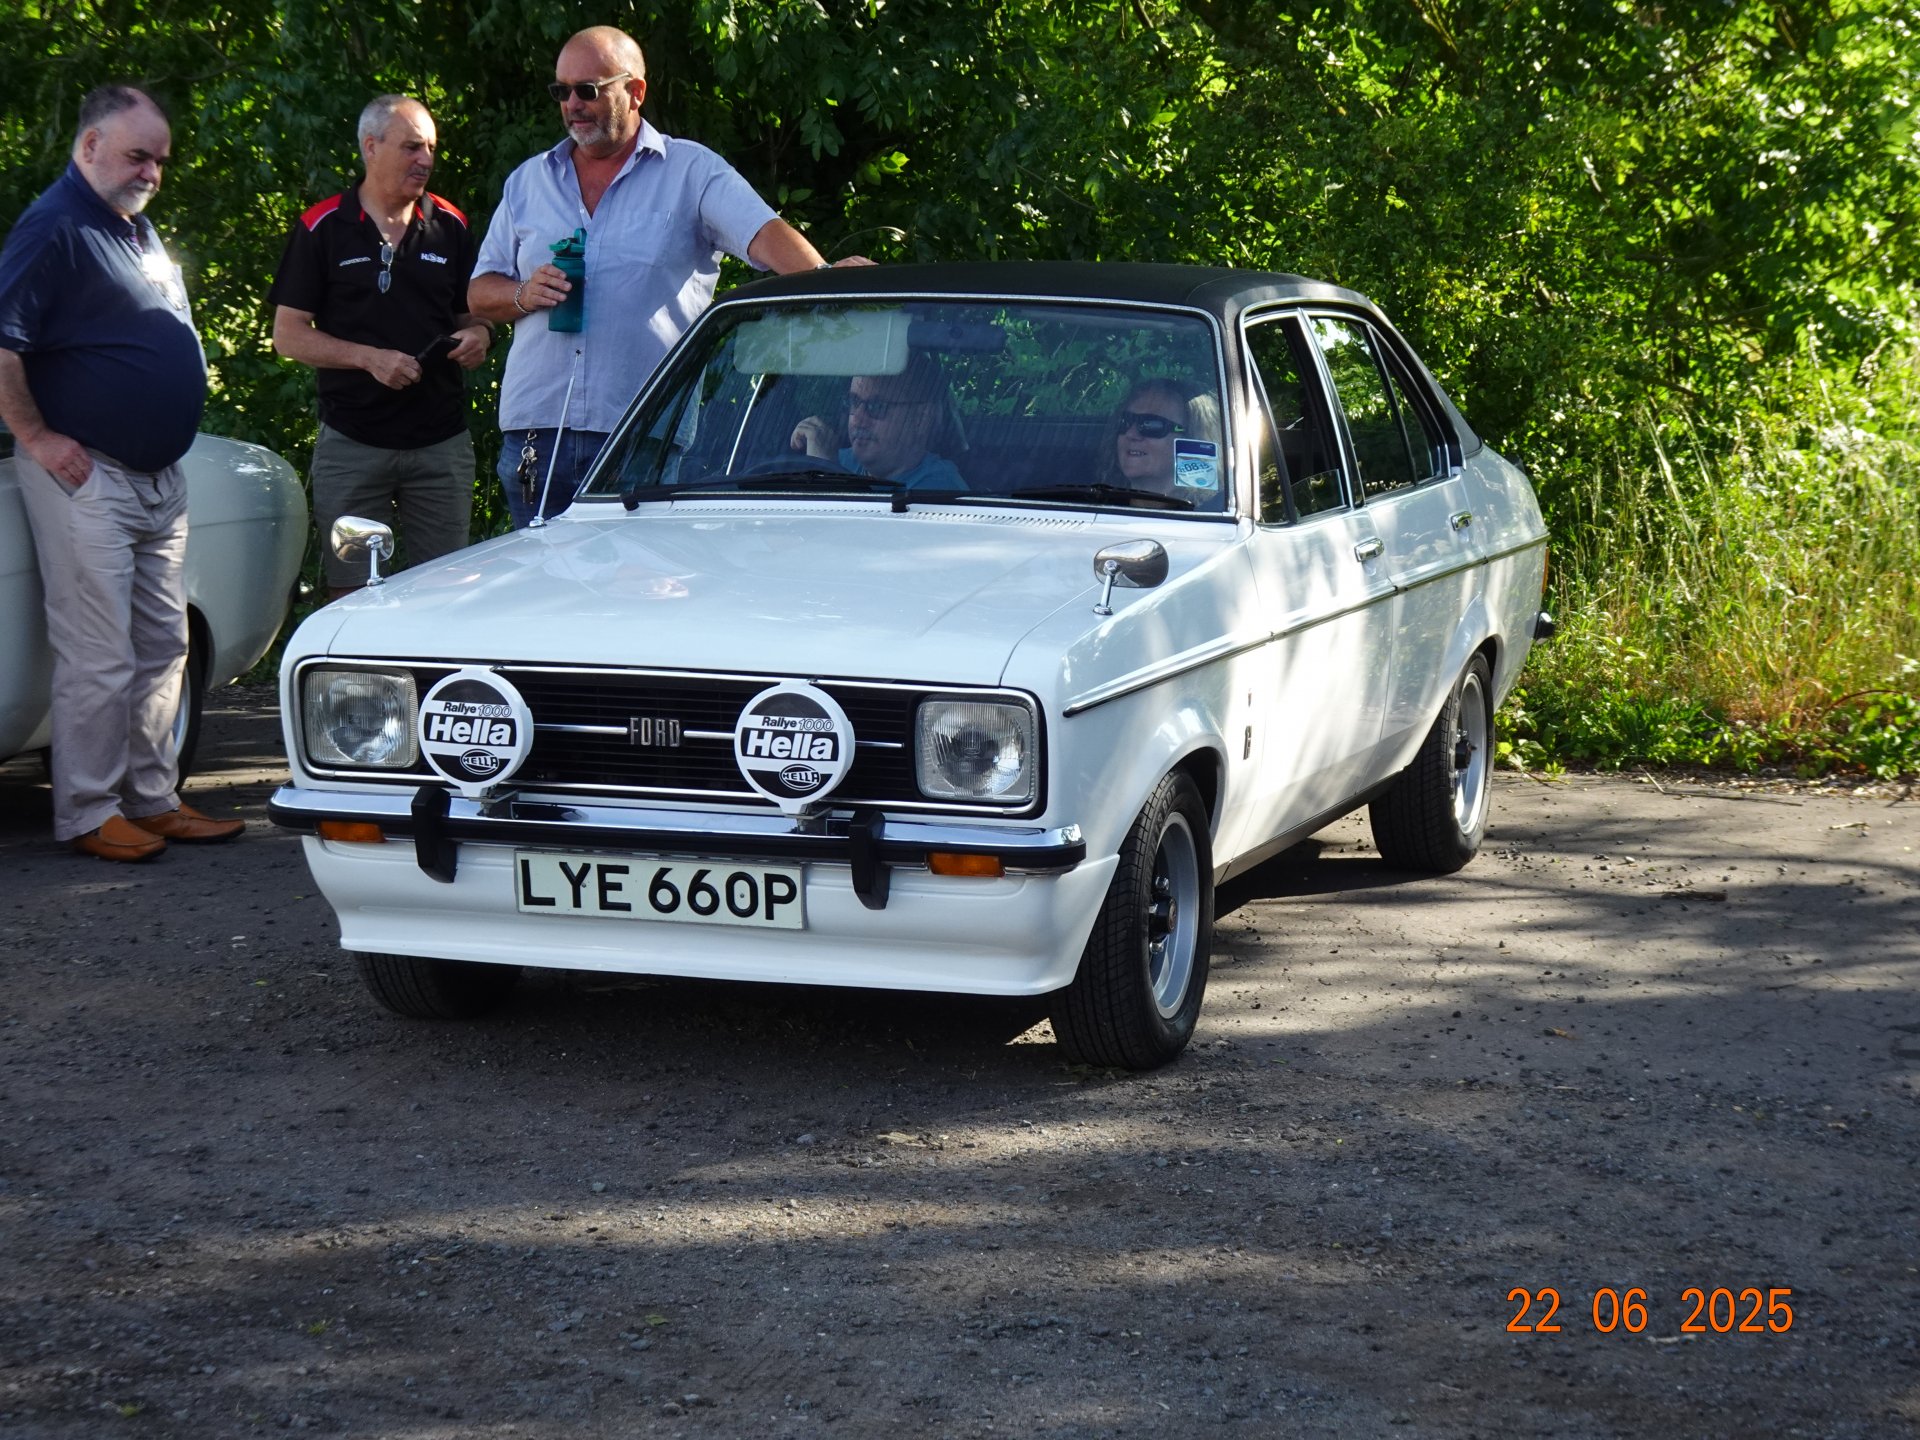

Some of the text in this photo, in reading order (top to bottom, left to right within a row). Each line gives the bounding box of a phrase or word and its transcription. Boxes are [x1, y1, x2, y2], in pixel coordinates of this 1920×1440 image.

[1184, 462, 1199, 472] 08
[443, 702, 512, 718] Rallye 1000
[429, 715, 511, 746] Hella
[761, 716, 835, 732] Rallye 1000
[629, 717, 681, 748] FORD
[746, 730, 833, 760] Hella
[462, 756, 499, 768] HELLA
[782, 771, 820, 783] HELLA
[520, 859, 798, 921] LYE 660P
